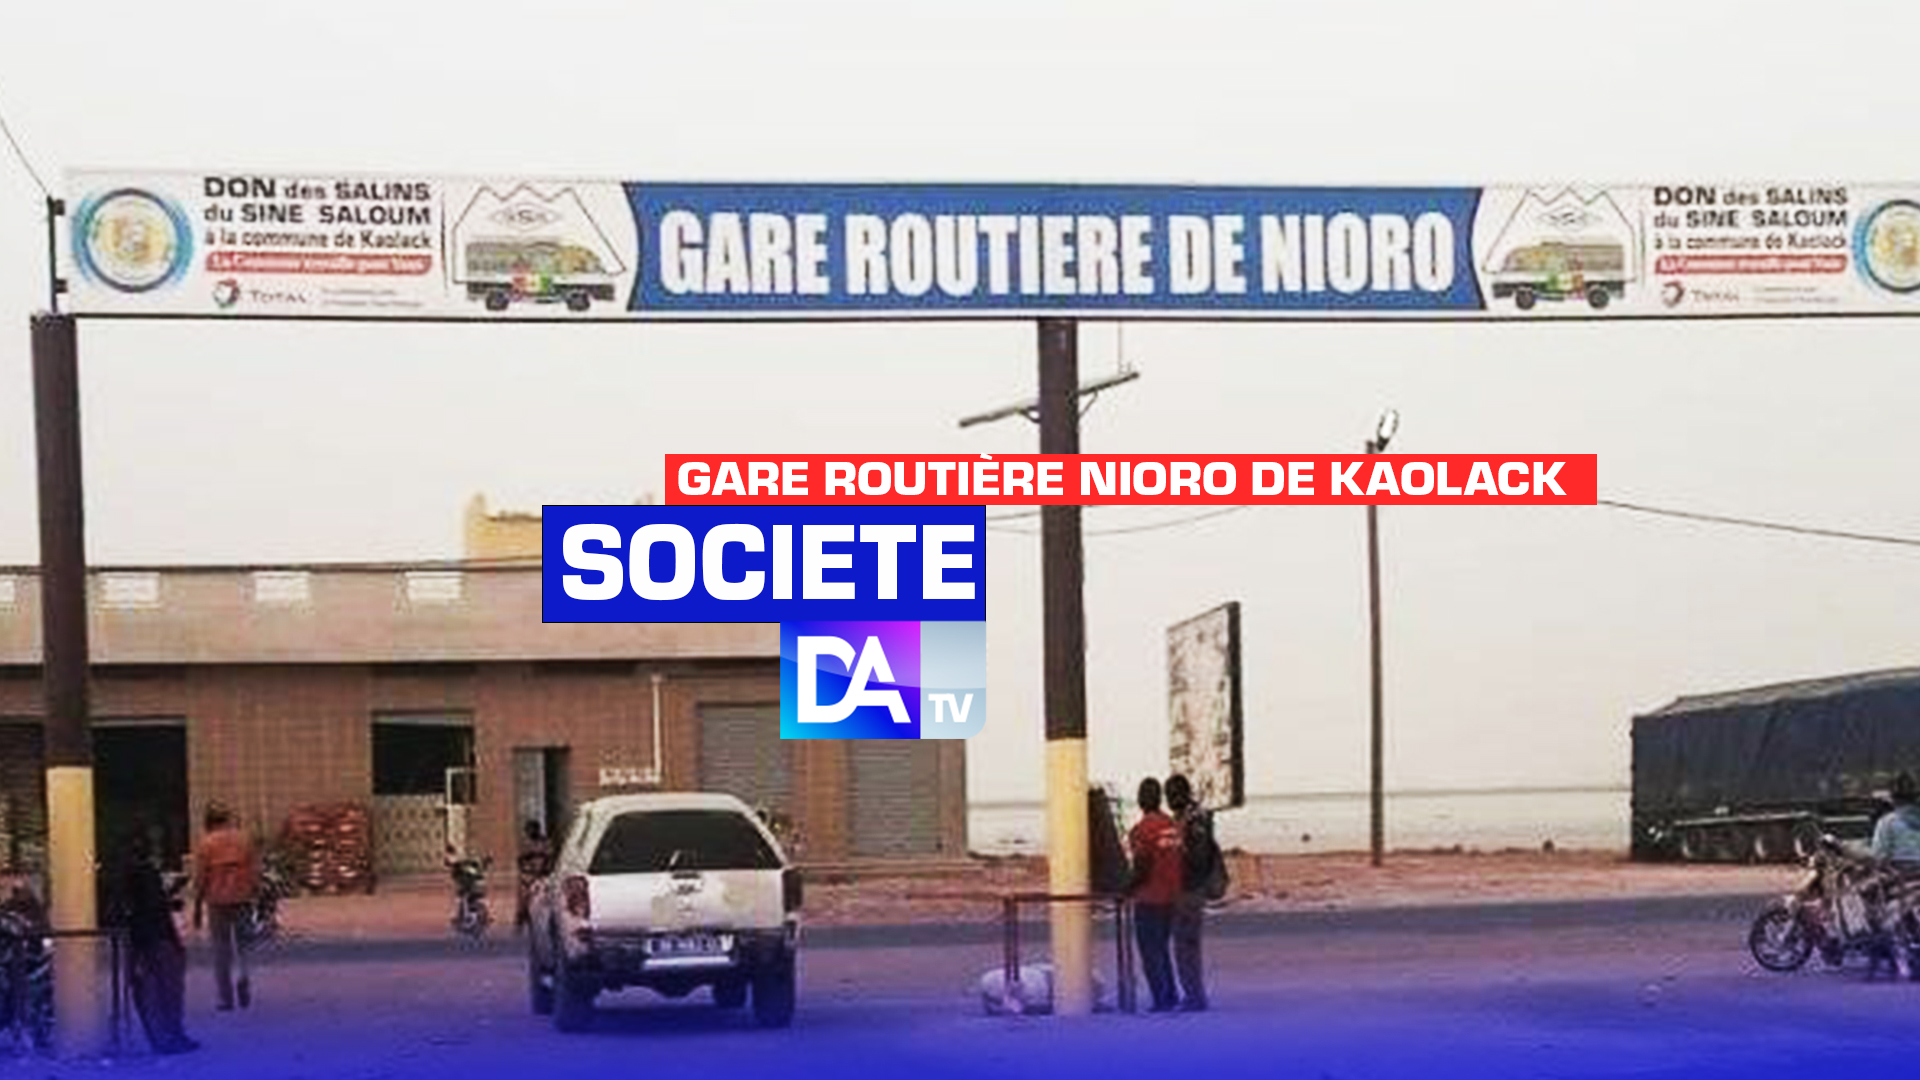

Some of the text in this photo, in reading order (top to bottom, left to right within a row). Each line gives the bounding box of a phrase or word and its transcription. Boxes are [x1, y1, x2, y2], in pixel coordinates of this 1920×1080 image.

[204, 176, 431, 201] DON des SALINS
[1654, 186, 1848, 206] DON des SALINS
[203, 203, 431, 225] du SINE SALOUM
[1654, 209, 1847, 228] du SINE SALOUM
[221, 229, 237, 246] la
[242, 232, 329, 248] commune
[334, 231, 354, 247] de
[360, 230, 431, 248] Kaolack
[660, 210, 1455, 297] GARE ROUTIERE DE NIORO
